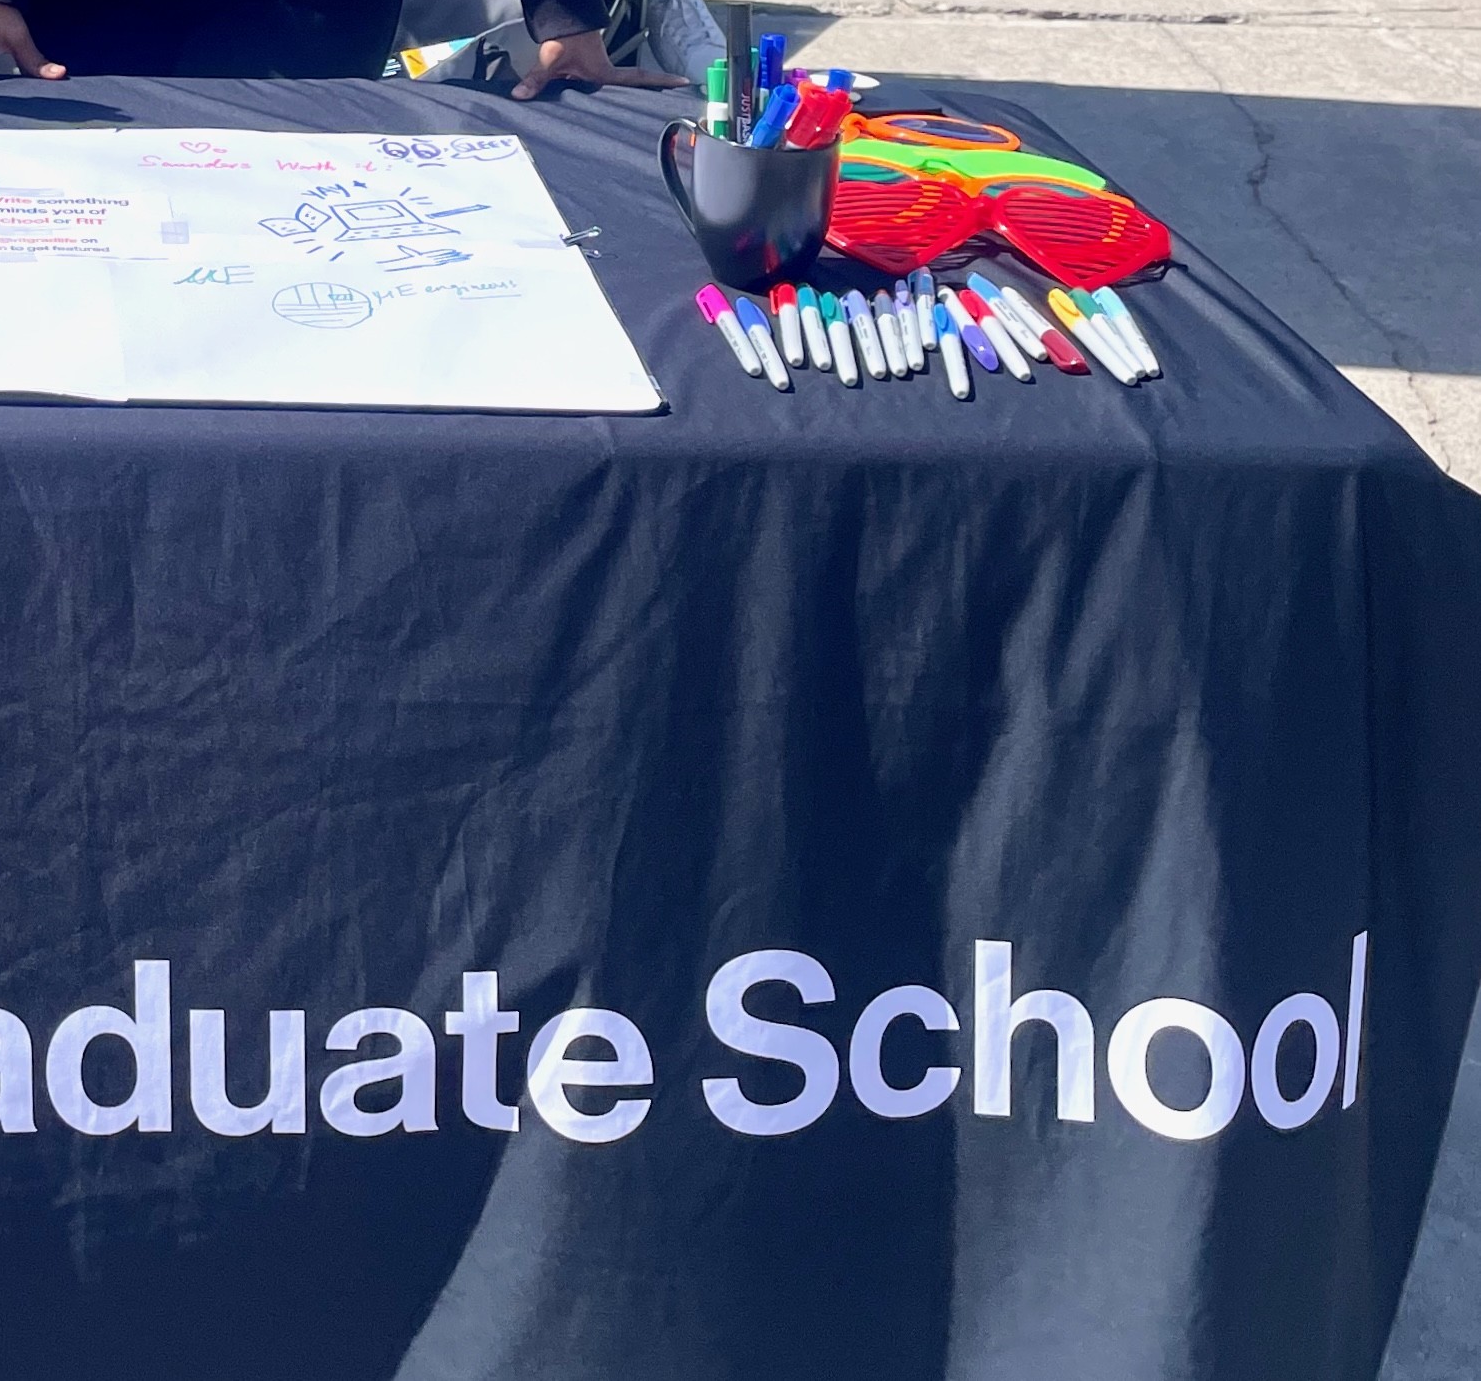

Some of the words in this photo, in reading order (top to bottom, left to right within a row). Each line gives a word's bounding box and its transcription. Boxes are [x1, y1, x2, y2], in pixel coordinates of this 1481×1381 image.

[36, 197, 130, 207] something
[51, 208, 85, 216] you
[88, 207, 107, 215] of
[75, 217, 107, 226] RIT
[702, 930, 1368, 1141] School
